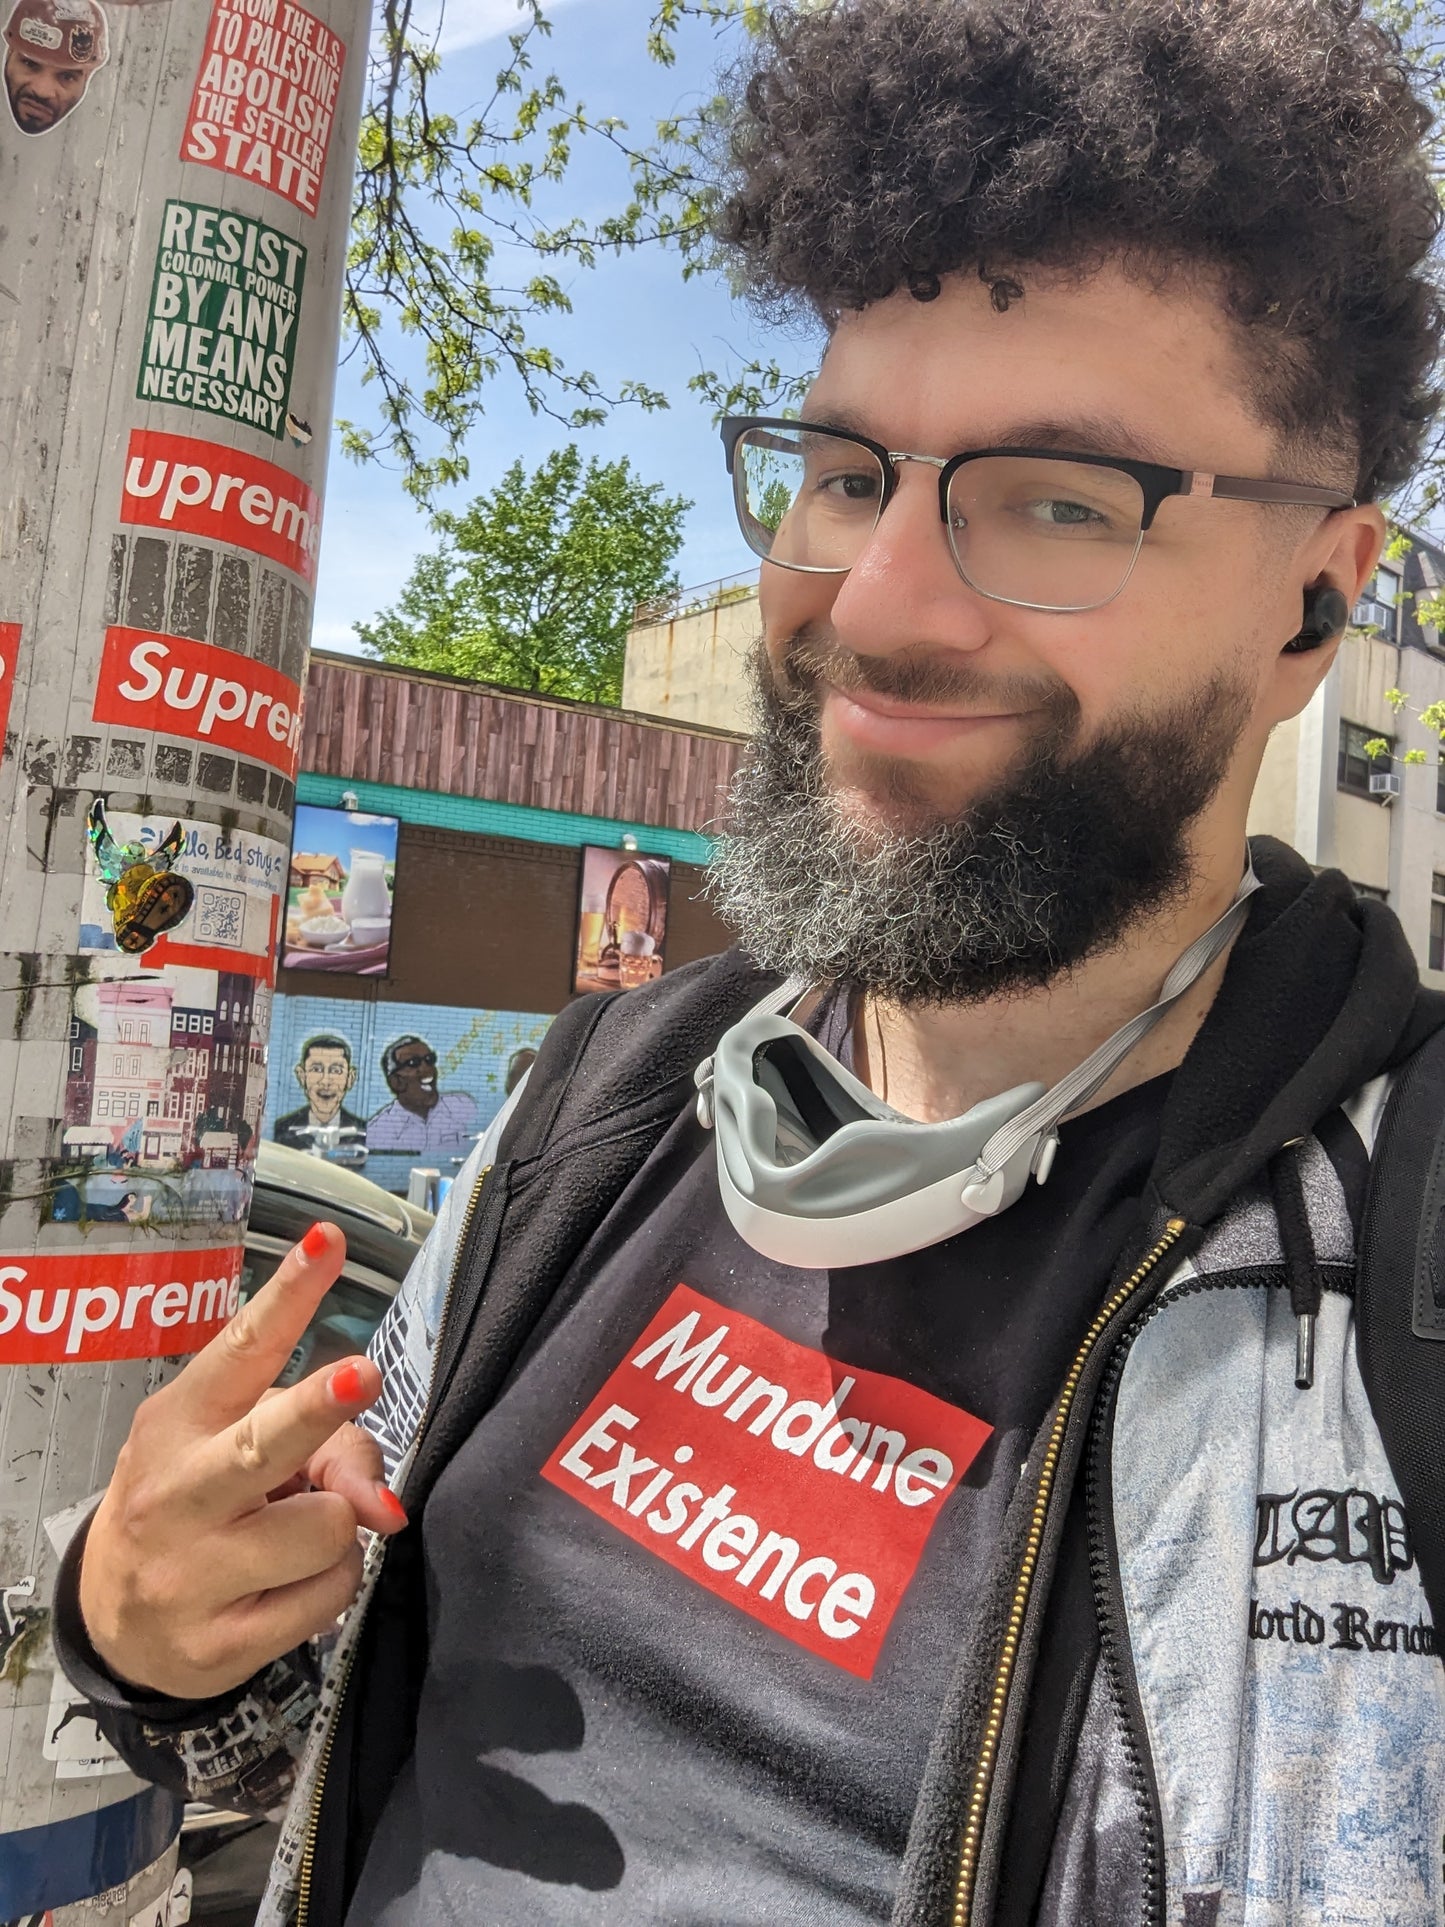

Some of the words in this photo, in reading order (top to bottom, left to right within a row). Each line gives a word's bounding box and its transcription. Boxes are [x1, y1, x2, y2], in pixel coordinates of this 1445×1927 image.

[213, 9, 242, 55] TO
[243, 20, 339, 113] PALESTINE
[221, 0, 278, 25] OM
[282, 3, 315, 46] THE
[316, 27, 340, 73] U.S.
[196, 90, 239, 127] THE
[242, 105, 323, 175] SETTLER
[200, 53, 331, 149] ABOLISH
[187, 121, 319, 213] STATE
[161, 250, 240, 288] COLONIAL
[245, 271, 297, 314] POWER
[162, 204, 303, 289] RESIST
[154, 272, 212, 323] BY
[218, 288, 295, 354] ANY
[142, 366, 284, 432] NECESSARY
[148, 319, 287, 401] MEANS
[215, 837, 242, 864] Bed
[0, 1266, 240, 1354] Supreme
[631, 1310, 954, 1507] Mundane
[559, 1402, 876, 1640] Existence
